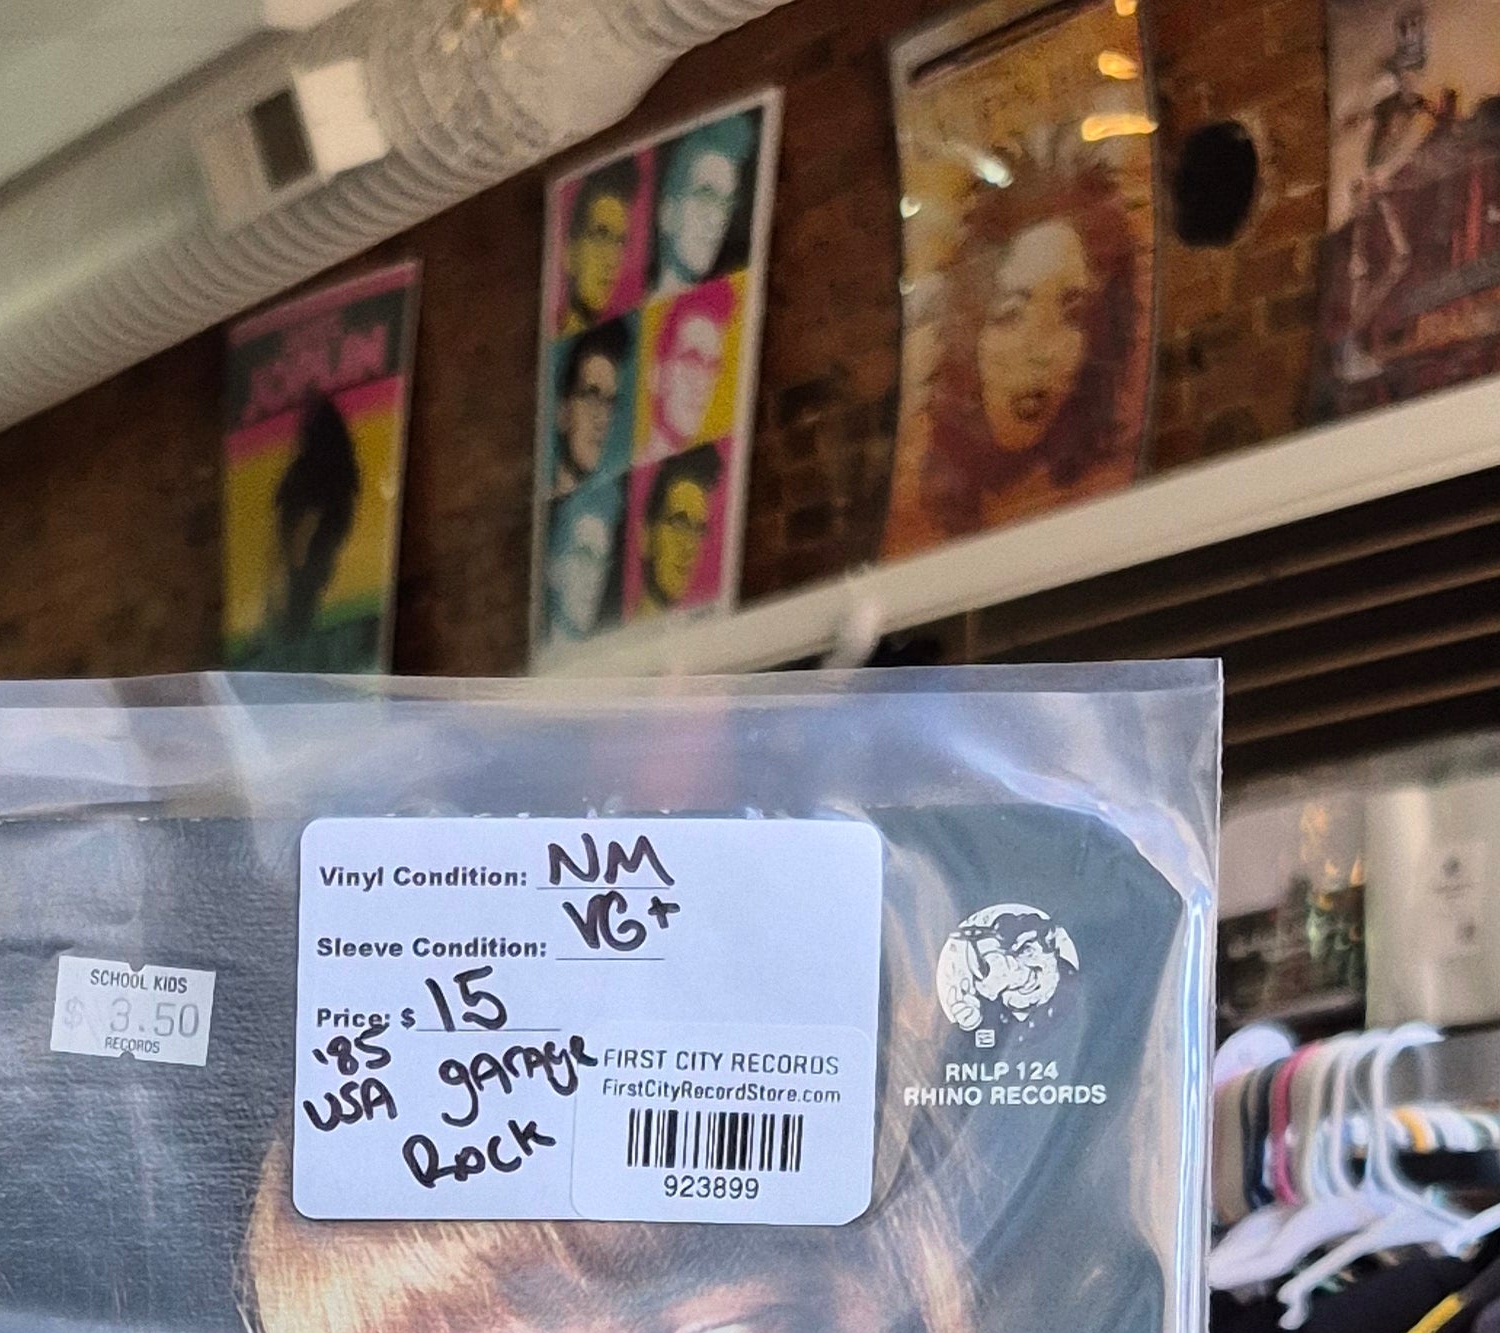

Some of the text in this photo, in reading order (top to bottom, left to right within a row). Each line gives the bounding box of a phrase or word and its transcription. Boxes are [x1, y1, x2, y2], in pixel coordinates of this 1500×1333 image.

[319, 832, 676, 893] Vinyl Condition: NM
[315, 889, 682, 958] Sleeve Condition: VG+
[89, 968, 188, 994] SCHOOL KIDS
[316, 964, 508, 1033] Price: $ 15
[108, 996, 200, 1038] 3.50
[104, 1035, 161, 1055] RECORDS
[311, 1023, 392, 1076] '85
[603, 1048, 840, 1075] FIRST CITY RECORDS
[945, 1060, 1059, 1082] RNLP 124
[302, 1076, 399, 1132] USA
[602, 1077, 842, 1104] FirstCityRecordStore.com
[903, 1083, 1108, 1107] RHINO RECORDS
[663, 1174, 760, 1200] 923899
